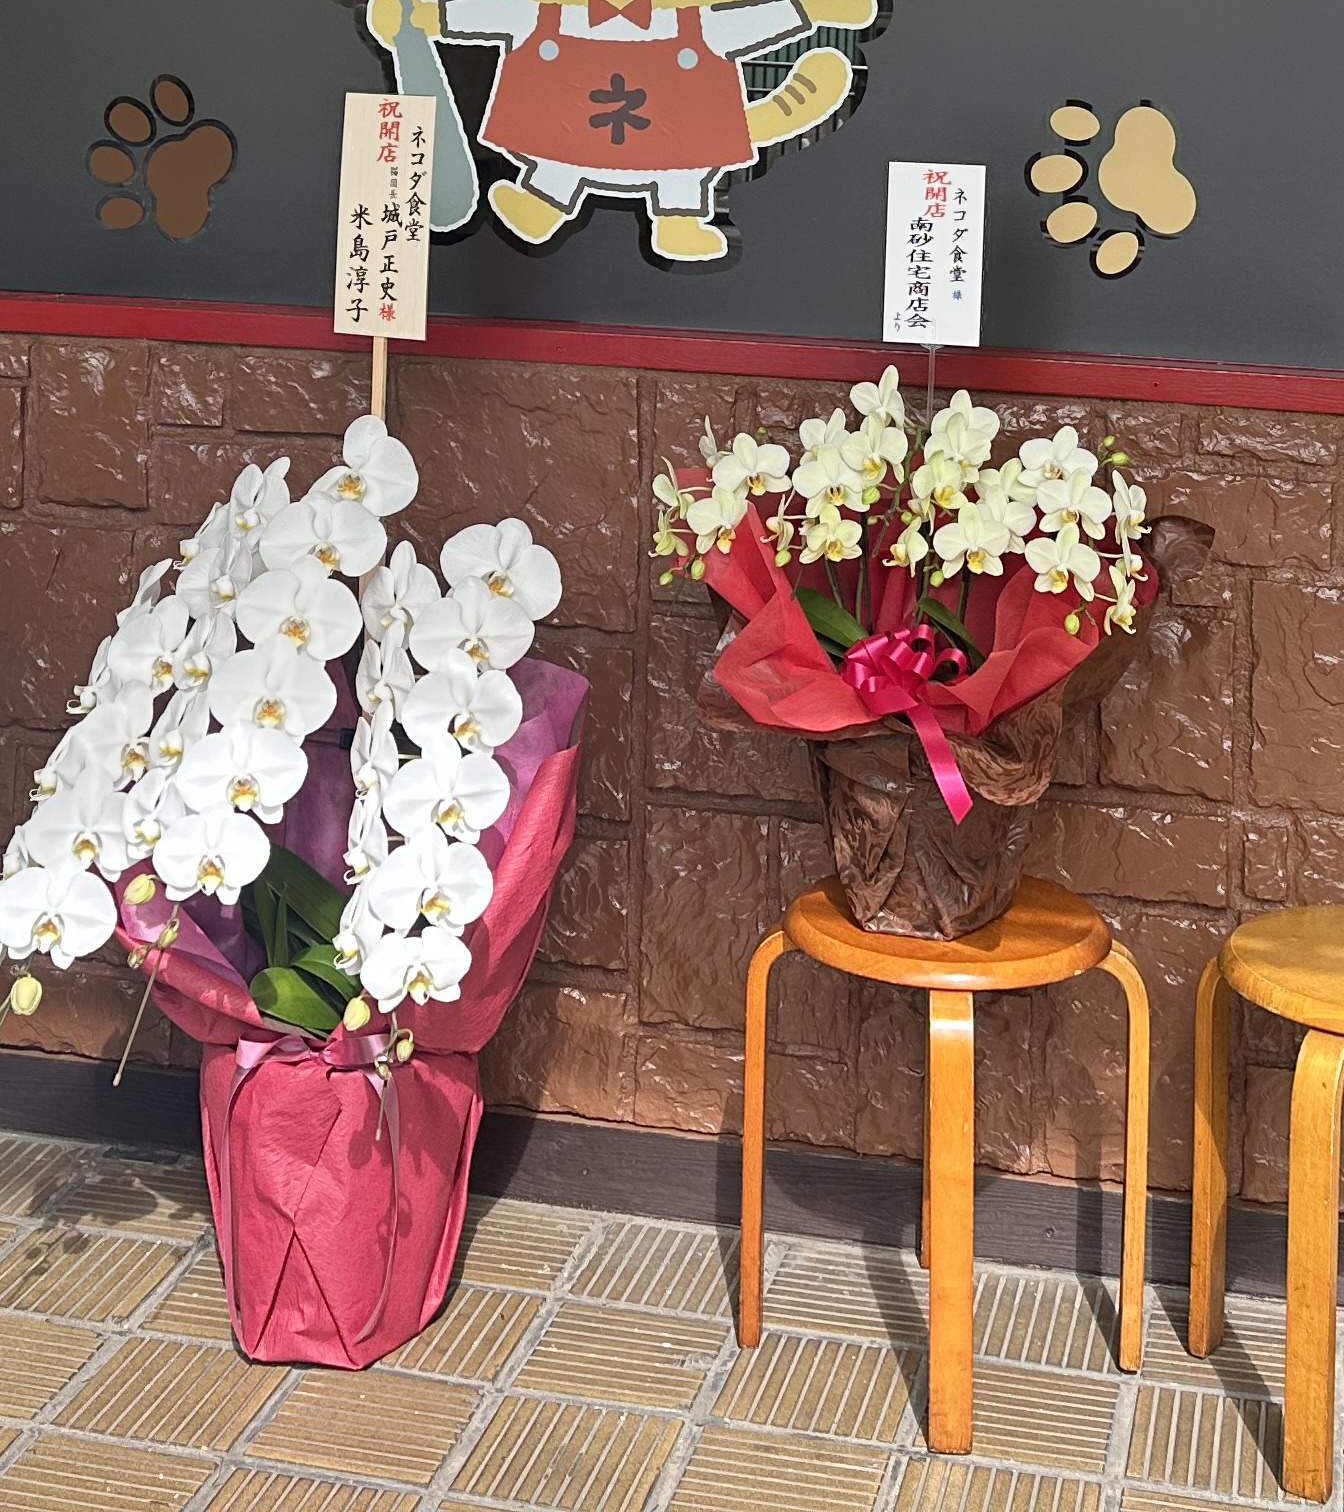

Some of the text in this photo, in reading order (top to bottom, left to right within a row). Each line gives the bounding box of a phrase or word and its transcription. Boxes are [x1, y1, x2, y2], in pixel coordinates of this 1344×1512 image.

[376, 98, 403, 163] 祝開店
[588, 72, 651, 145] ネ
[404, 125, 428, 243] ネコダ食堂
[921, 168, 952, 218] 祝開店
[345, 203, 374, 323] 米島淳子
[903, 216, 934, 329] 南砂住宅商店会
[948, 187, 969, 283] ネコダ食堂
